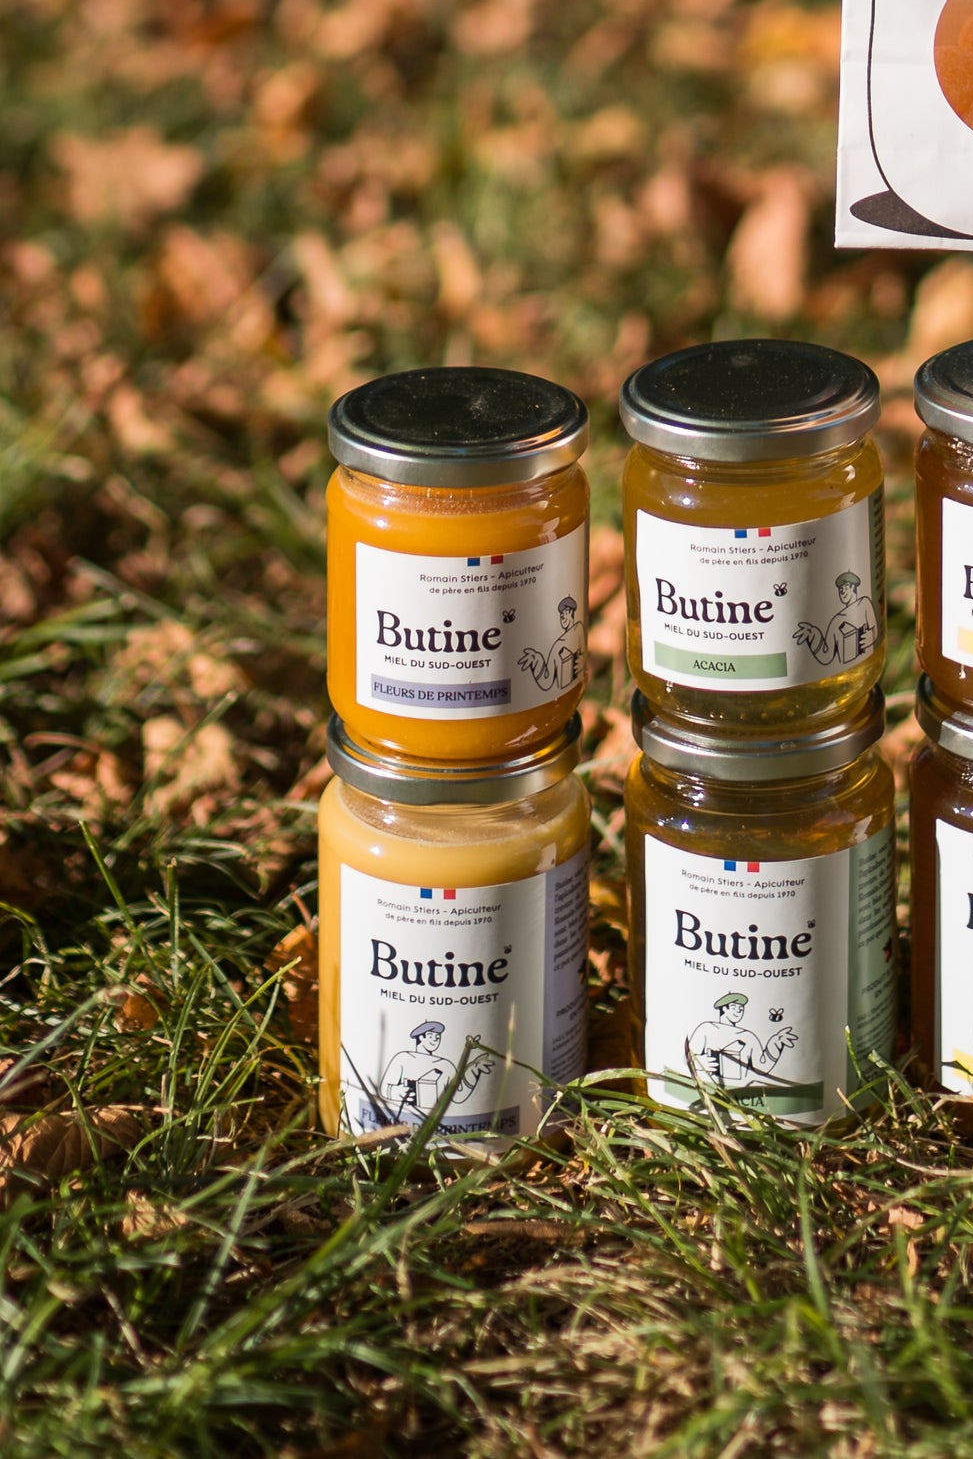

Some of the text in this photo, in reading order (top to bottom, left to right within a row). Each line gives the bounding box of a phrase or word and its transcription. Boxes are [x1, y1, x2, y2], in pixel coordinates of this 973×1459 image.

[690, 537, 816, 554] Romain Stiers Apiculteur
[712, 558, 731, 566] père
[733, 558, 743, 566] en
[760, 554, 789, 565] depuis
[790, 551, 809, 560] 1970
[419, 563, 545, 583] Romain Stiers Apiculteur
[442, 586, 462, 595] père
[491, 581, 518, 592] depuis
[520, 576, 537, 586] 1970
[655, 578, 774, 624] Butine
[376, 610, 502, 653] Butine
[664, 623, 765, 641] MIEL DU SUD-OUEST
[384, 655, 492, 670] MIEL DU SUD-OUEST
[693, 659, 736, 672] ACACIA
[373, 682, 508, 701] FLEURS DE PRINTEMPS
[681, 869, 805, 889] Romain Stiers Apiculteur
[689, 883, 699, 891] de
[700, 886, 719, 896] père
[720, 889, 731, 897] en
[747, 891, 775, 900] depuis
[777, 889, 796, 898] 1970
[377, 898, 502, 915] Romain Stiers Apiculteur
[385, 912, 395, 920] de
[396, 915, 415, 924] père
[416, 917, 427, 925] en
[445, 919, 471, 927] depuis
[473, 916, 492, 924] 1970
[674, 908, 813, 960] Butine
[370, 938, 509, 988] Butine
[684, 958, 803, 978] MIEL DU SUD-OUEST
[380, 988, 499, 1006] MIEL DU SUD-OUEST
